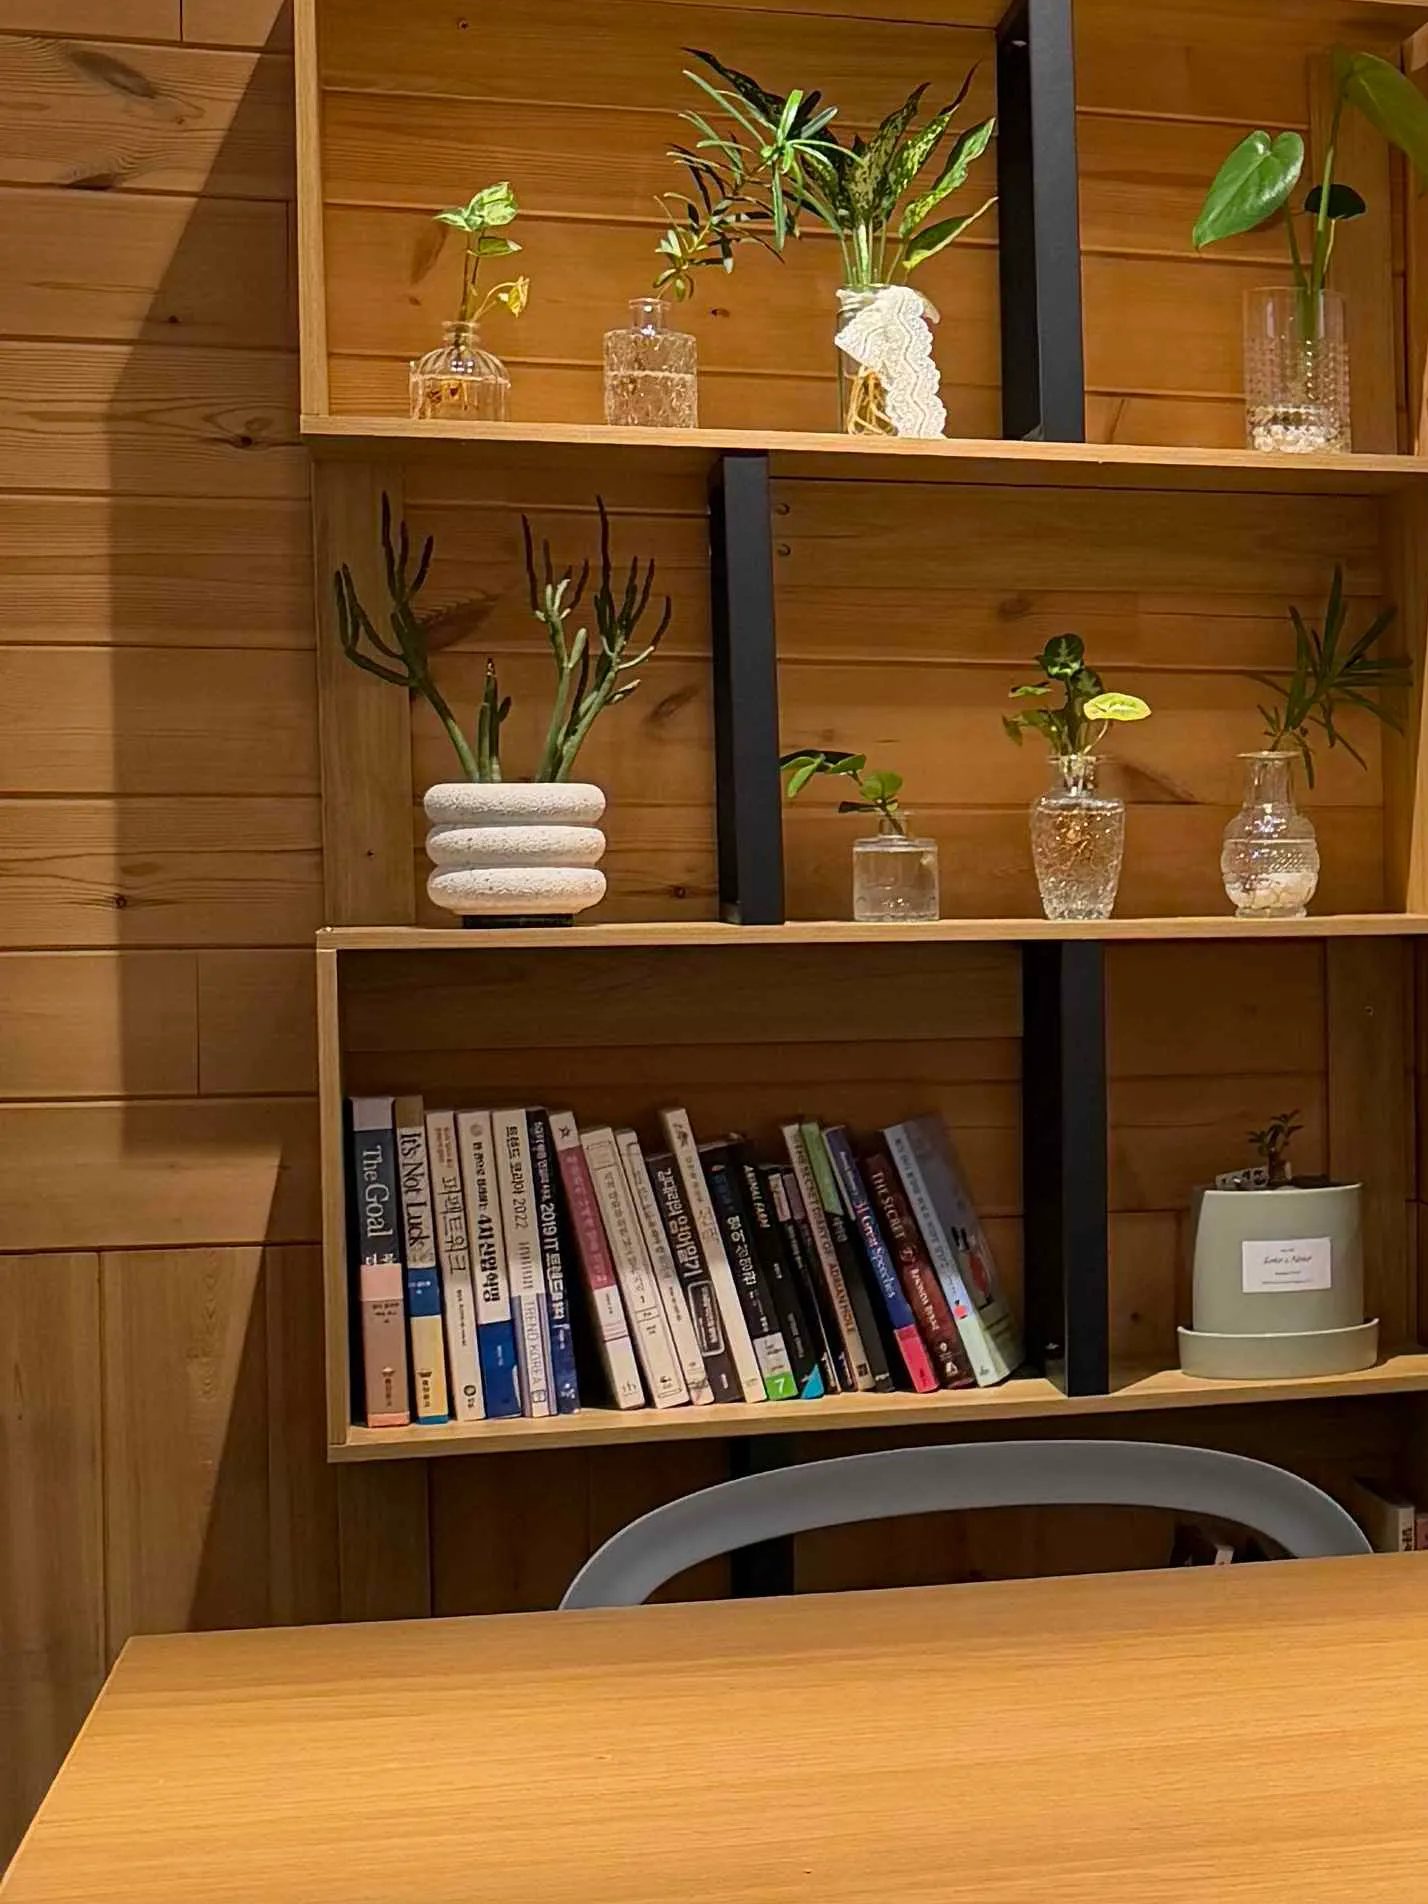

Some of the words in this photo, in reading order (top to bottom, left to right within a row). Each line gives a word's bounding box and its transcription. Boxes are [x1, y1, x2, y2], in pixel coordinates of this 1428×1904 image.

[401, 1132, 421, 1159] It's
[506, 1126, 521, 1160] 트렌드
[363, 1144, 383, 1181] The
[402, 1162, 425, 1194] Not
[511, 1161, 525, 1195] 코리아
[657, 1167, 685, 1217] 김대리의
[365, 1184, 393, 1238] Goal
[406, 1200, 430, 1247] Luck
[513, 1197, 529, 1230] 2022
[540, 1202, 558, 1237] 2019
[543, 1240, 560, 1251] IT
[668, 1215, 704, 1278] 영어일기
[860, 1214, 878, 1247] Great
[870, 1245, 896, 1299] Speeches
[524, 1300, 539, 1341] TREND
[529, 1345, 543, 1386] KOREA
